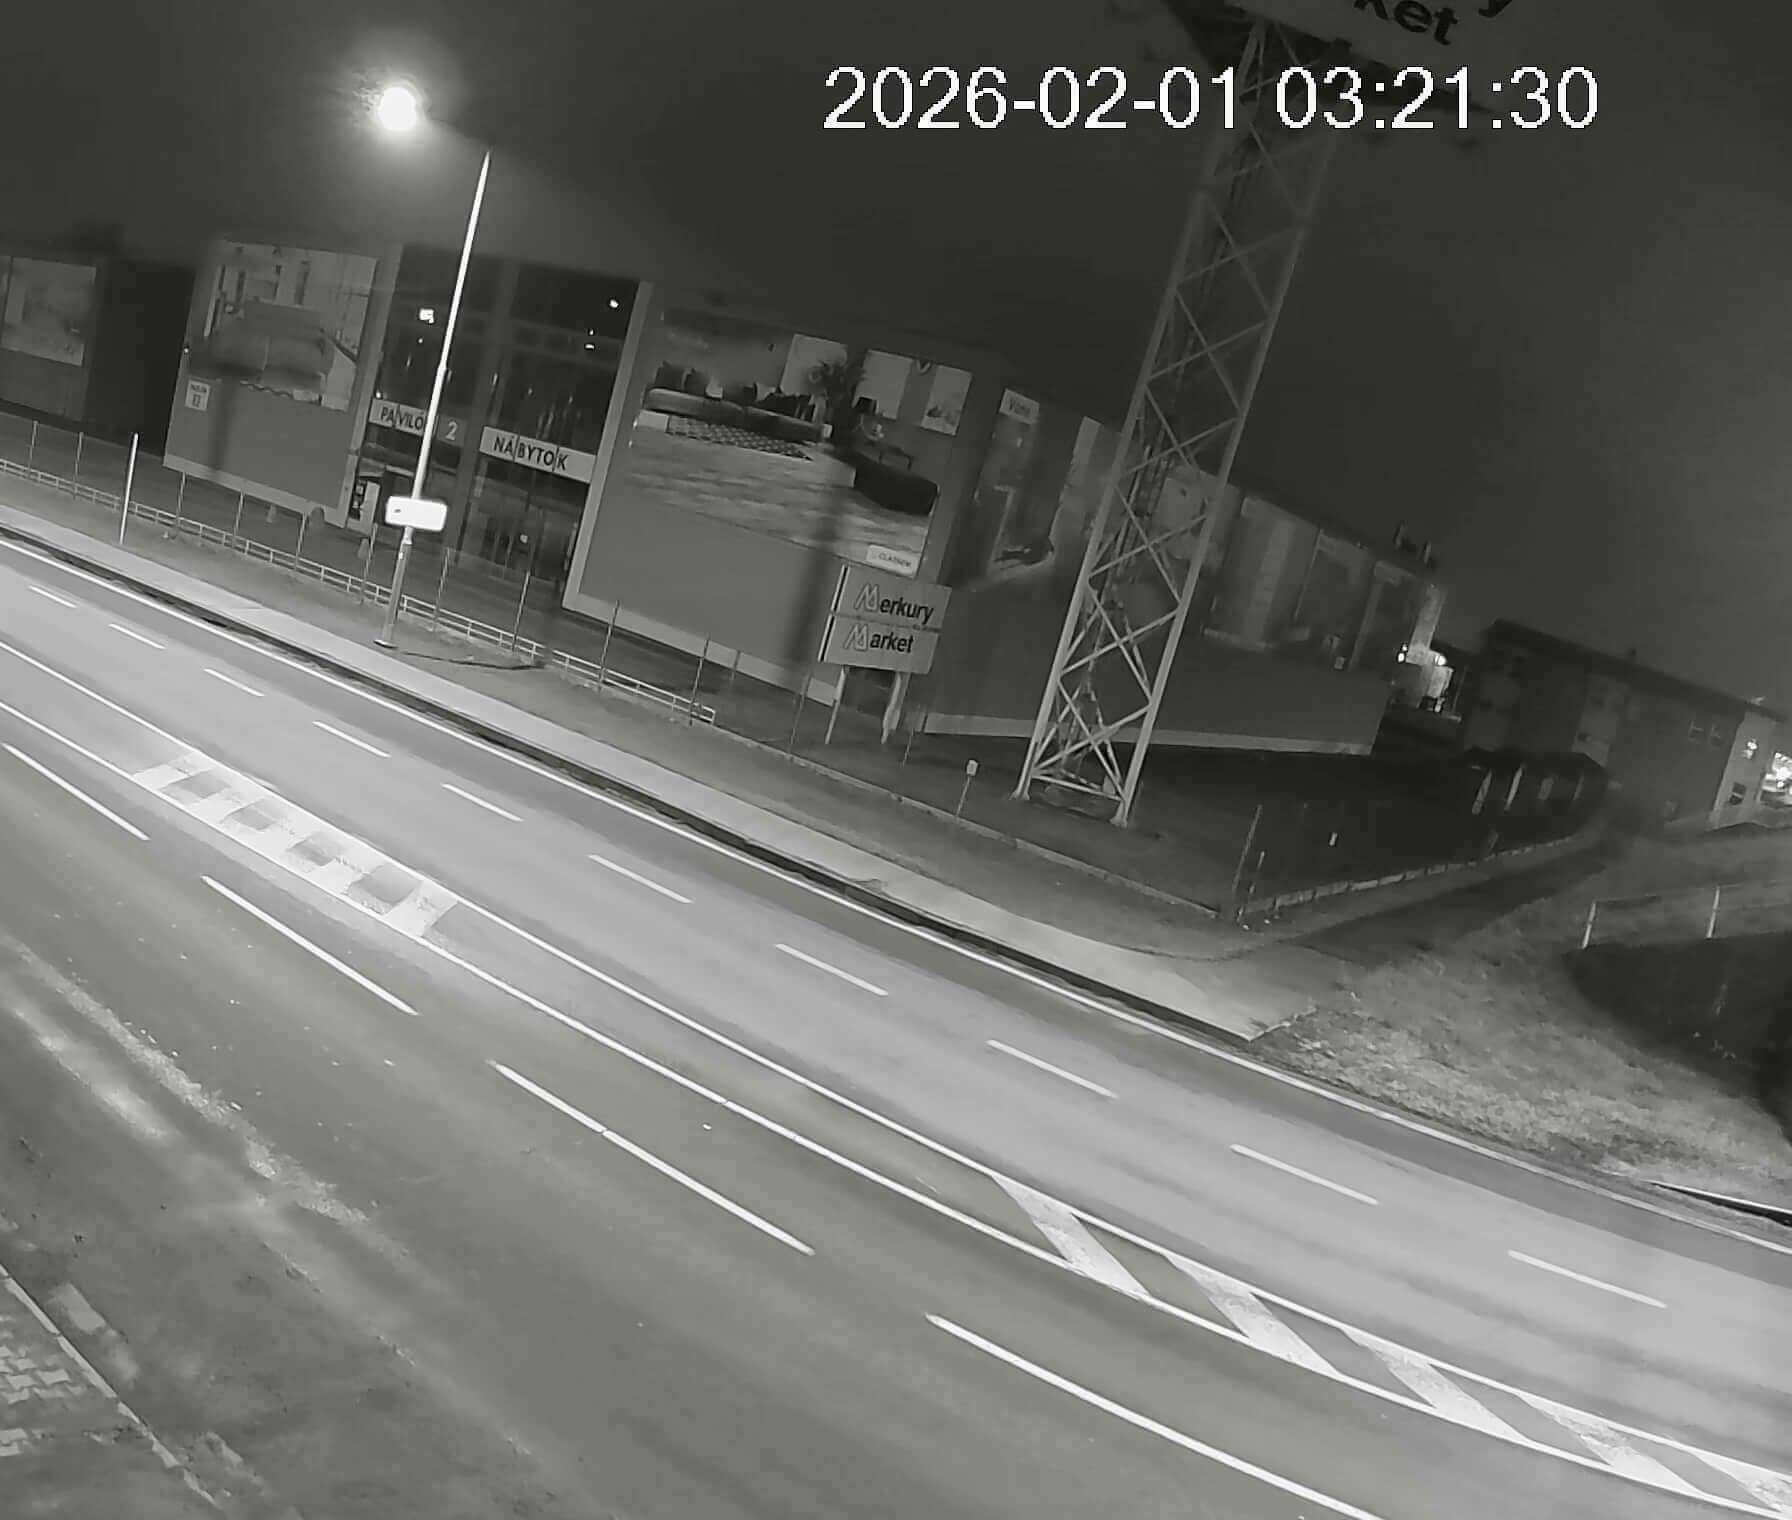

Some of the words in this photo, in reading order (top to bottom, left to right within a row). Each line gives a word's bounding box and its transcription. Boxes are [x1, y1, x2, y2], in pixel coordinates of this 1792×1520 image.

[379, 406, 428, 432] PAVILÓ
[445, 420, 458, 441] 2
[853, 582, 935, 626] Merkury
[843, 622, 915, 654] Market
